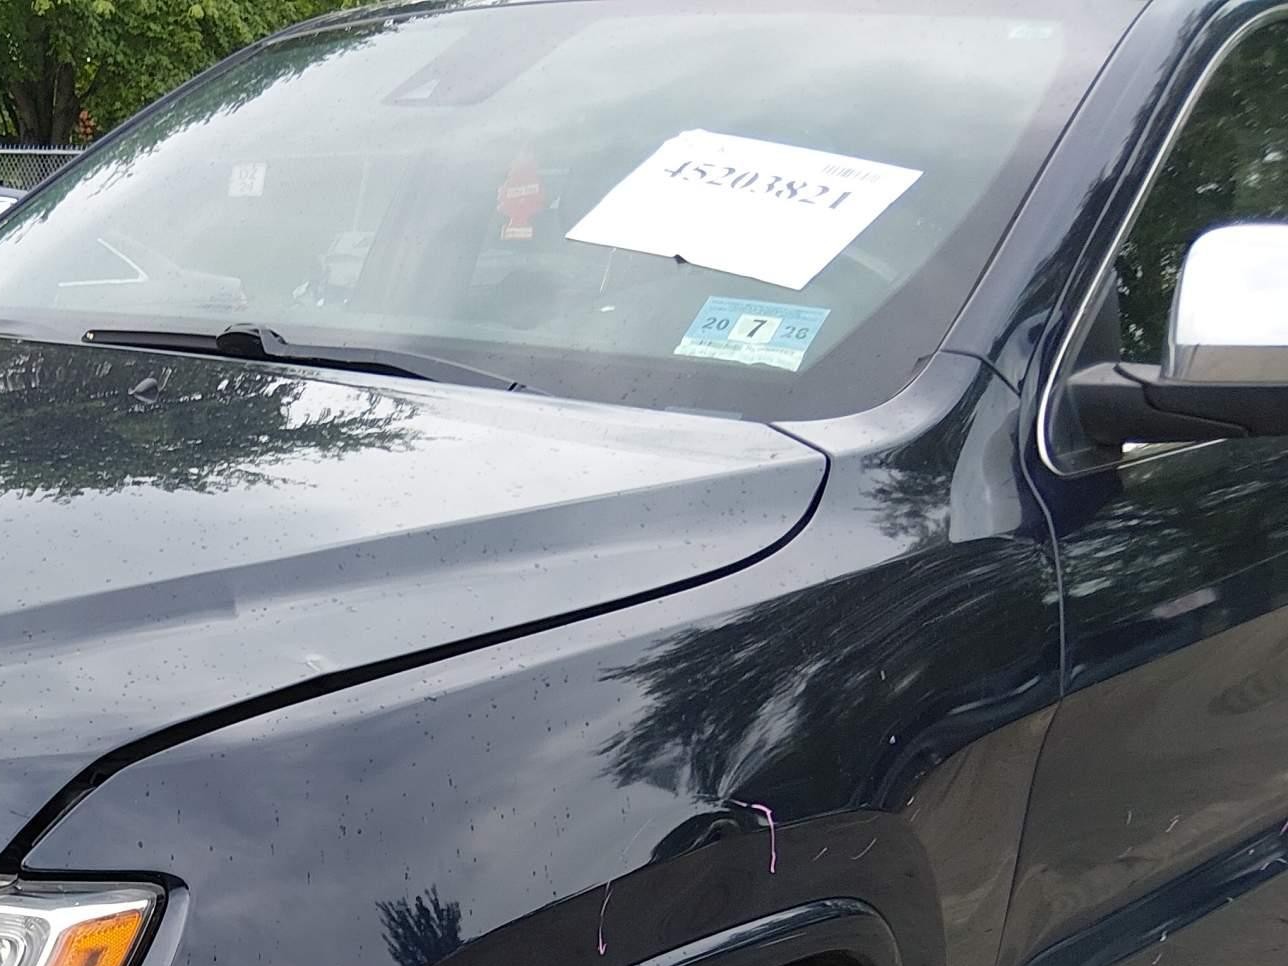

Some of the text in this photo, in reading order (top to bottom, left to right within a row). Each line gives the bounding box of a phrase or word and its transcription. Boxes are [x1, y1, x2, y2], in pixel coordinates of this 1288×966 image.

[664, 160, 853, 209] 45203821
[701, 316, 810, 341] 20 7 26
